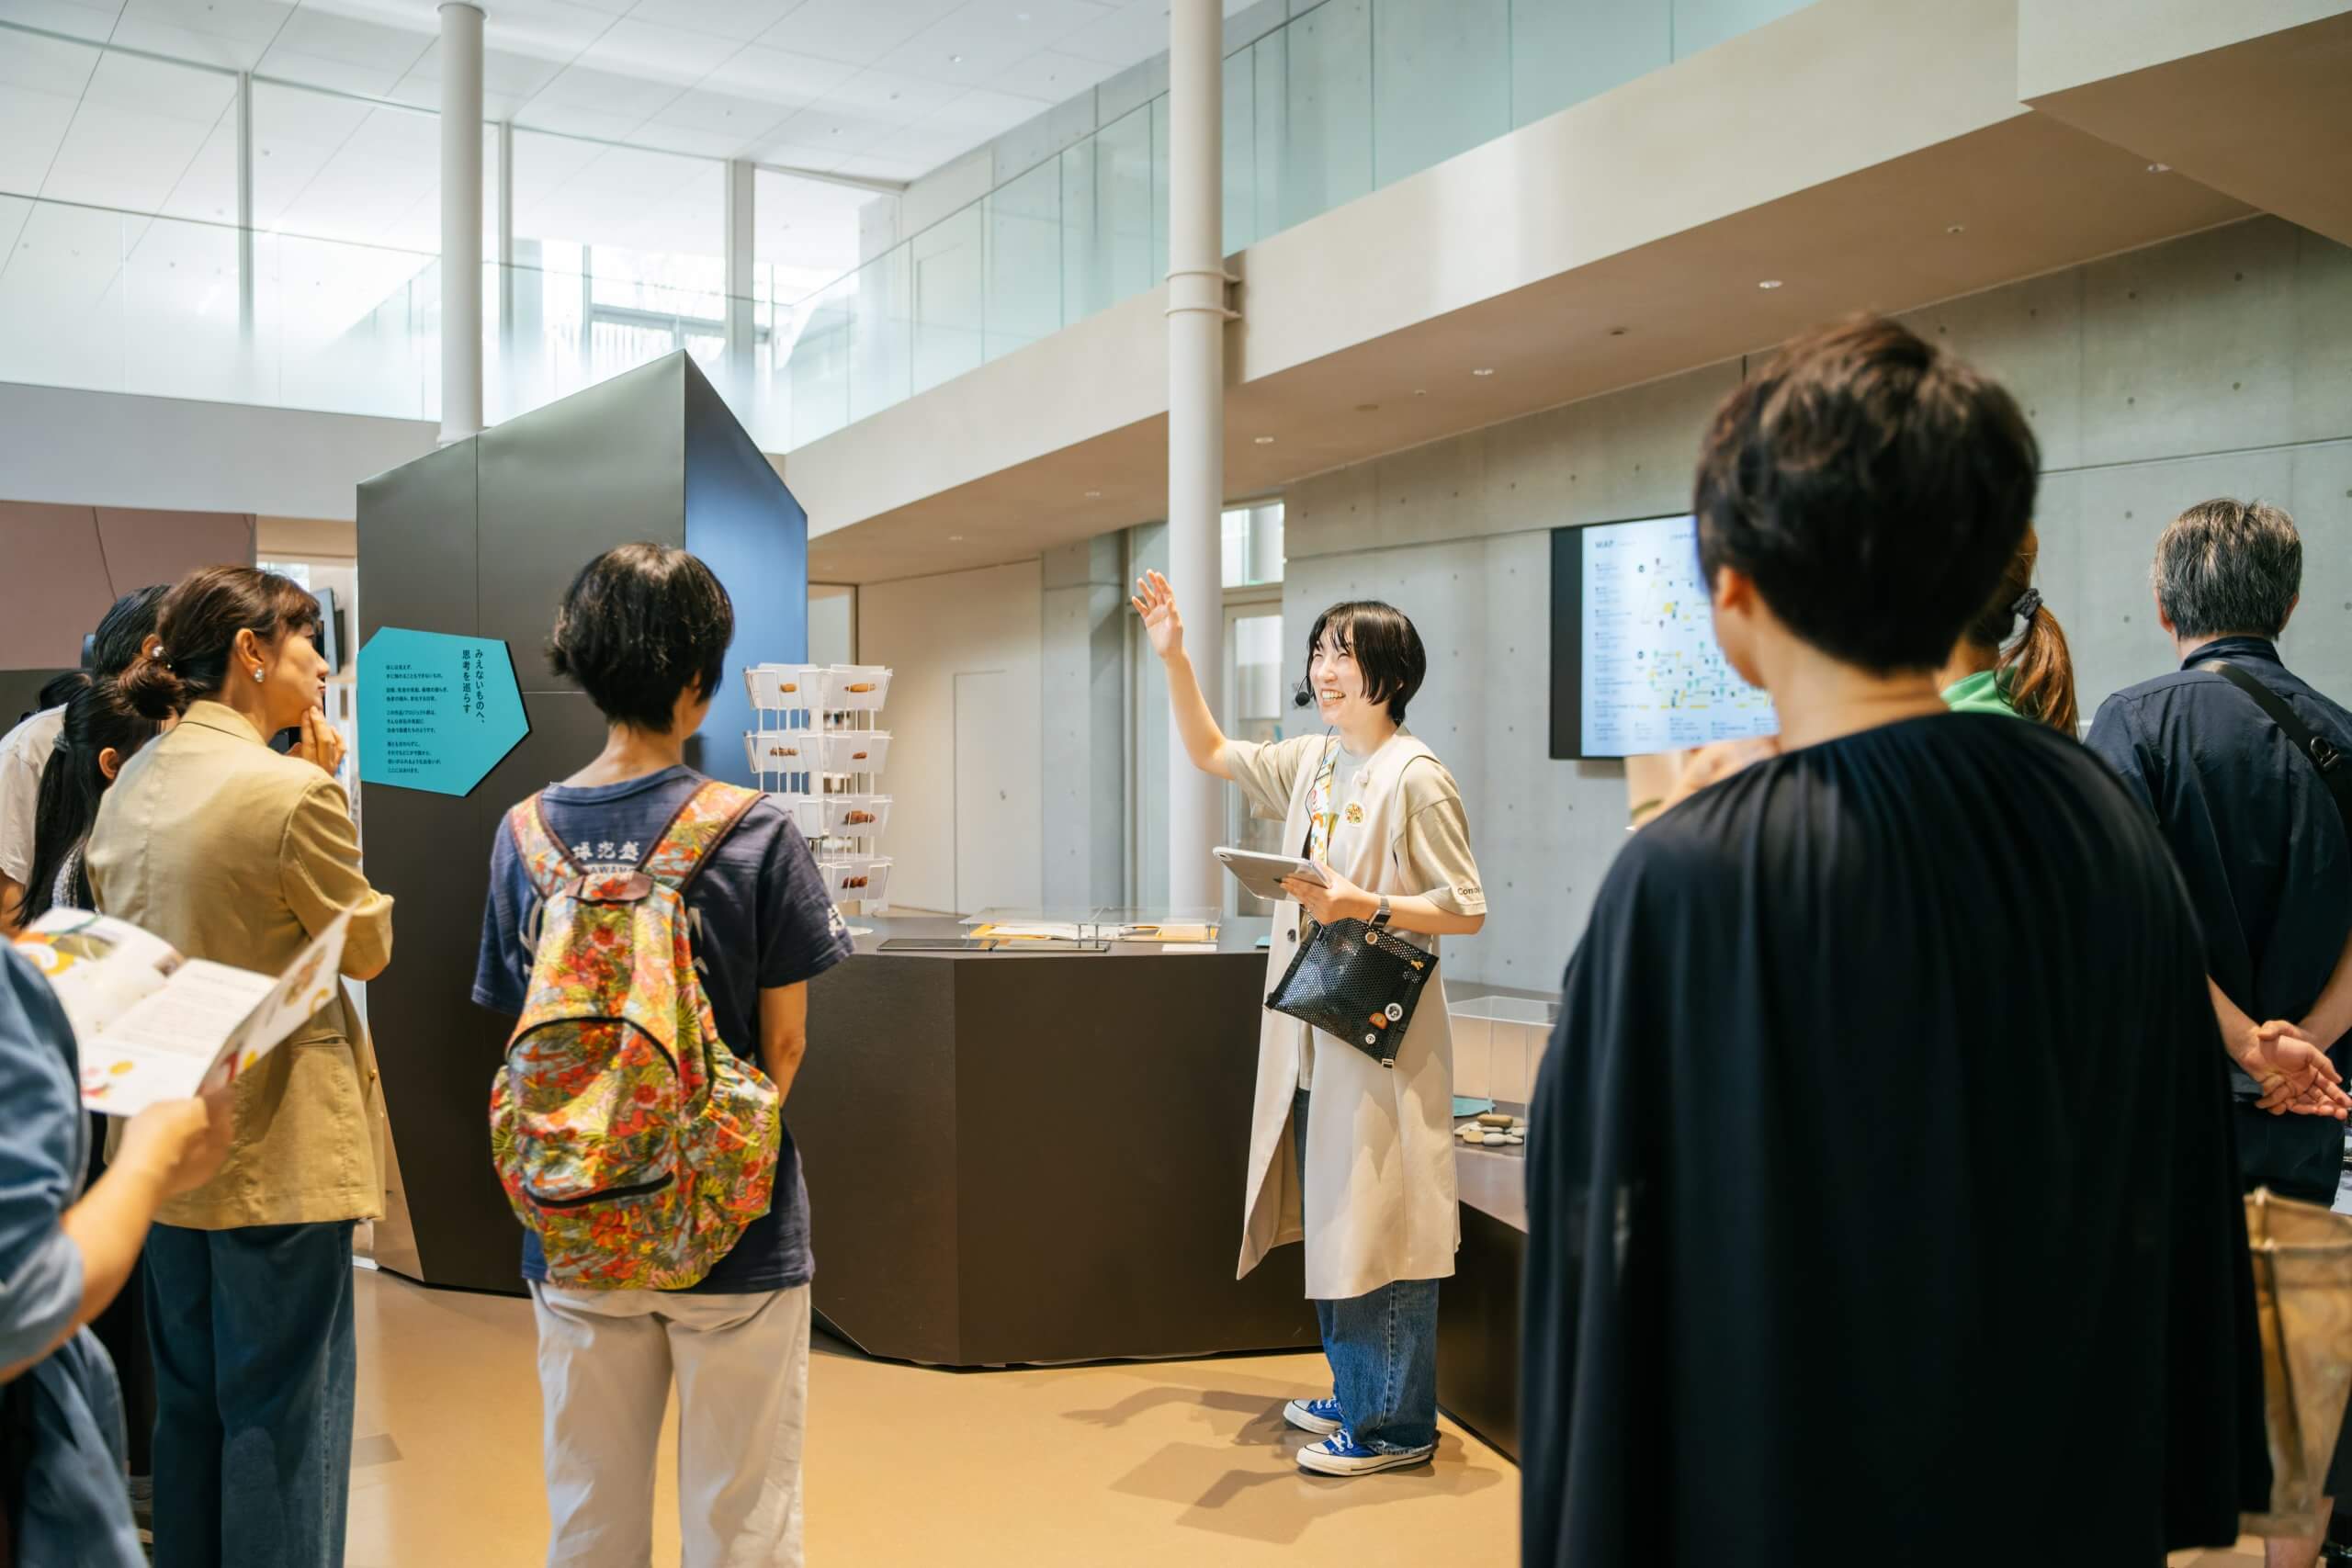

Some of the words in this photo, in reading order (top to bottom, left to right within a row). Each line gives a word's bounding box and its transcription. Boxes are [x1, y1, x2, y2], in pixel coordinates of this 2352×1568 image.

[462, 649, 471, 714] 思考を巡らす
[474, 649, 485, 724] みえないものへ、
